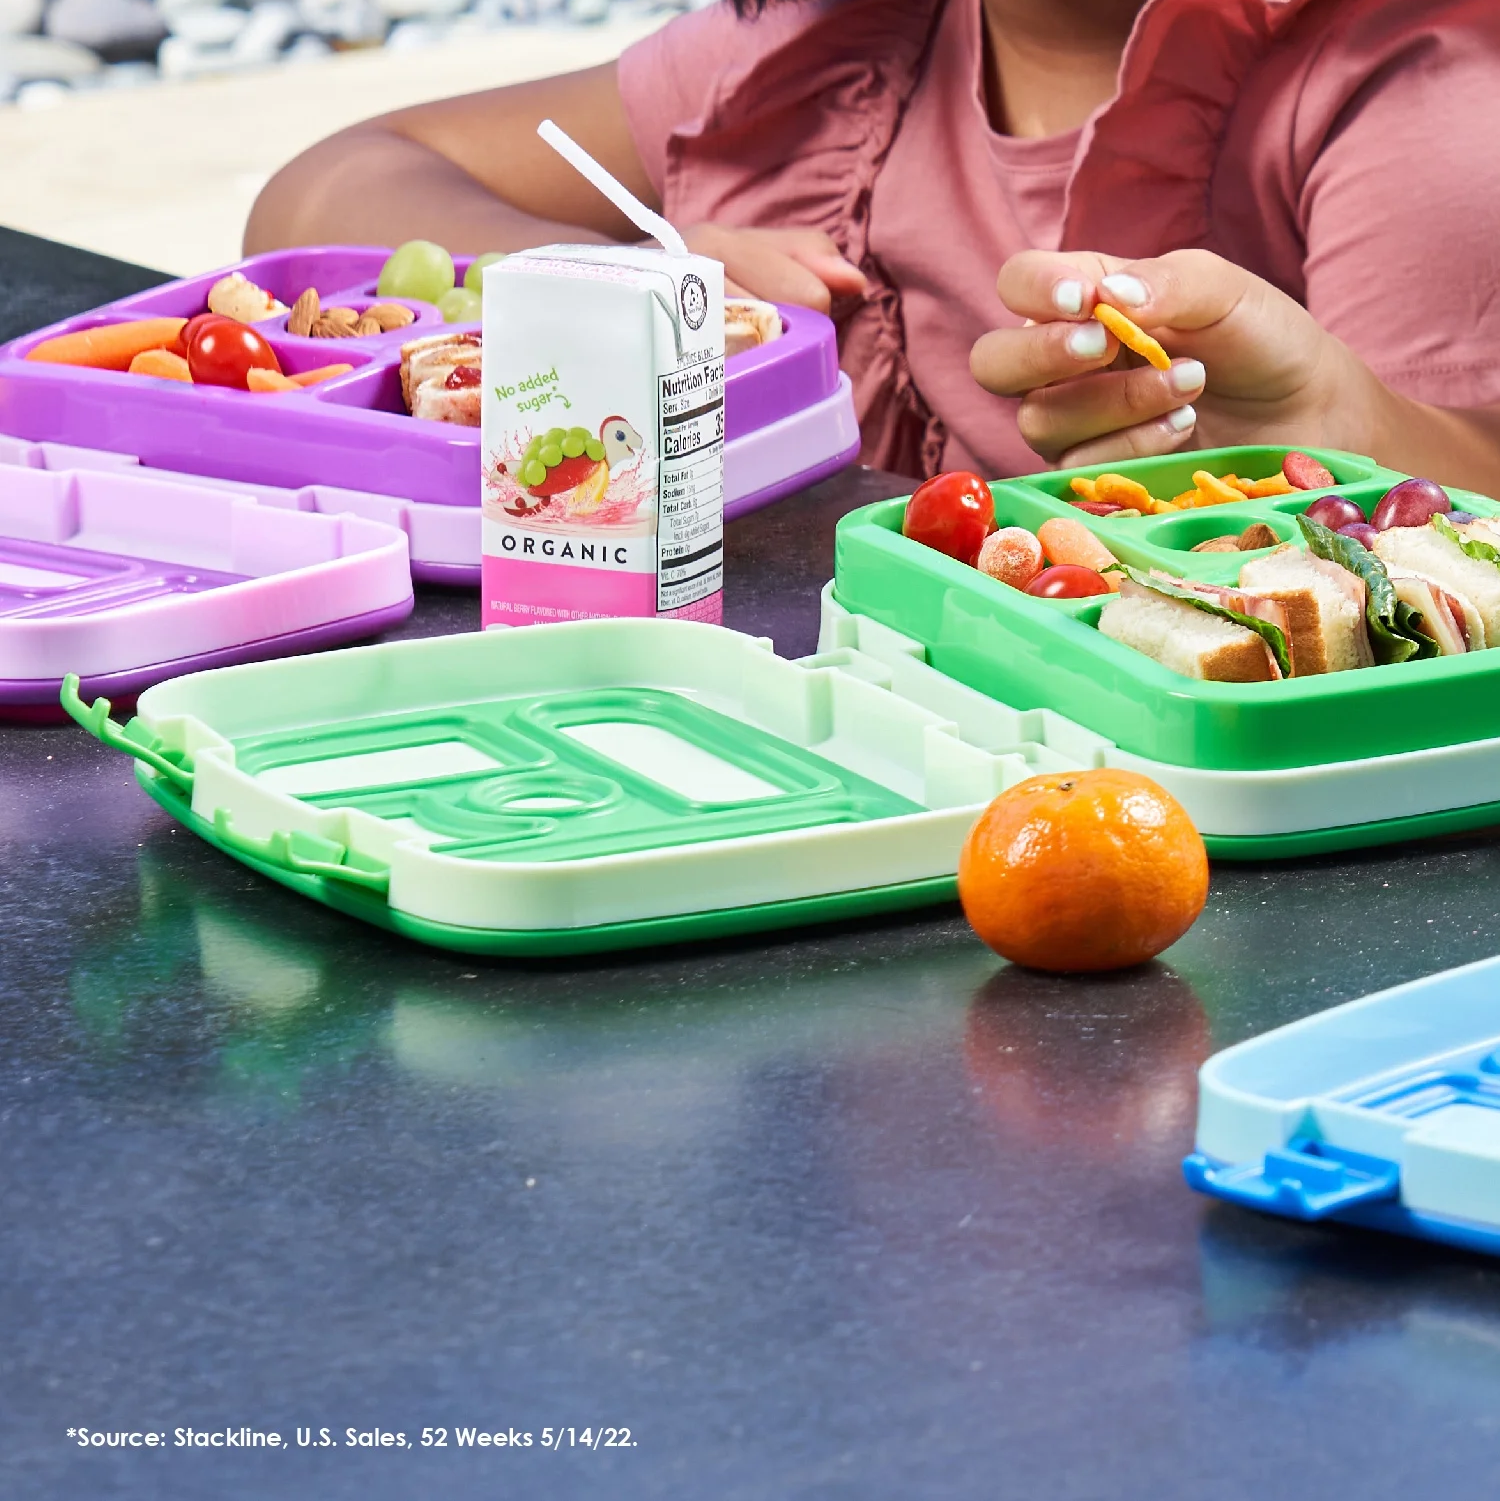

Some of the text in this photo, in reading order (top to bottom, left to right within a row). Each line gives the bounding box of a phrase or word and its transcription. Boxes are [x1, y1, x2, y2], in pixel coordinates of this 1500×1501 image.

[495, 367, 559, 402] No added
[662, 371, 703, 399] Nutrition
[664, 431, 701, 455] Calories
[664, 473, 680, 484] Total
[681, 470, 689, 481] Fat
[663, 503, 679, 514] Total
[501, 535, 628, 565] ORGANIC
[662, 546, 684, 558] Protein
